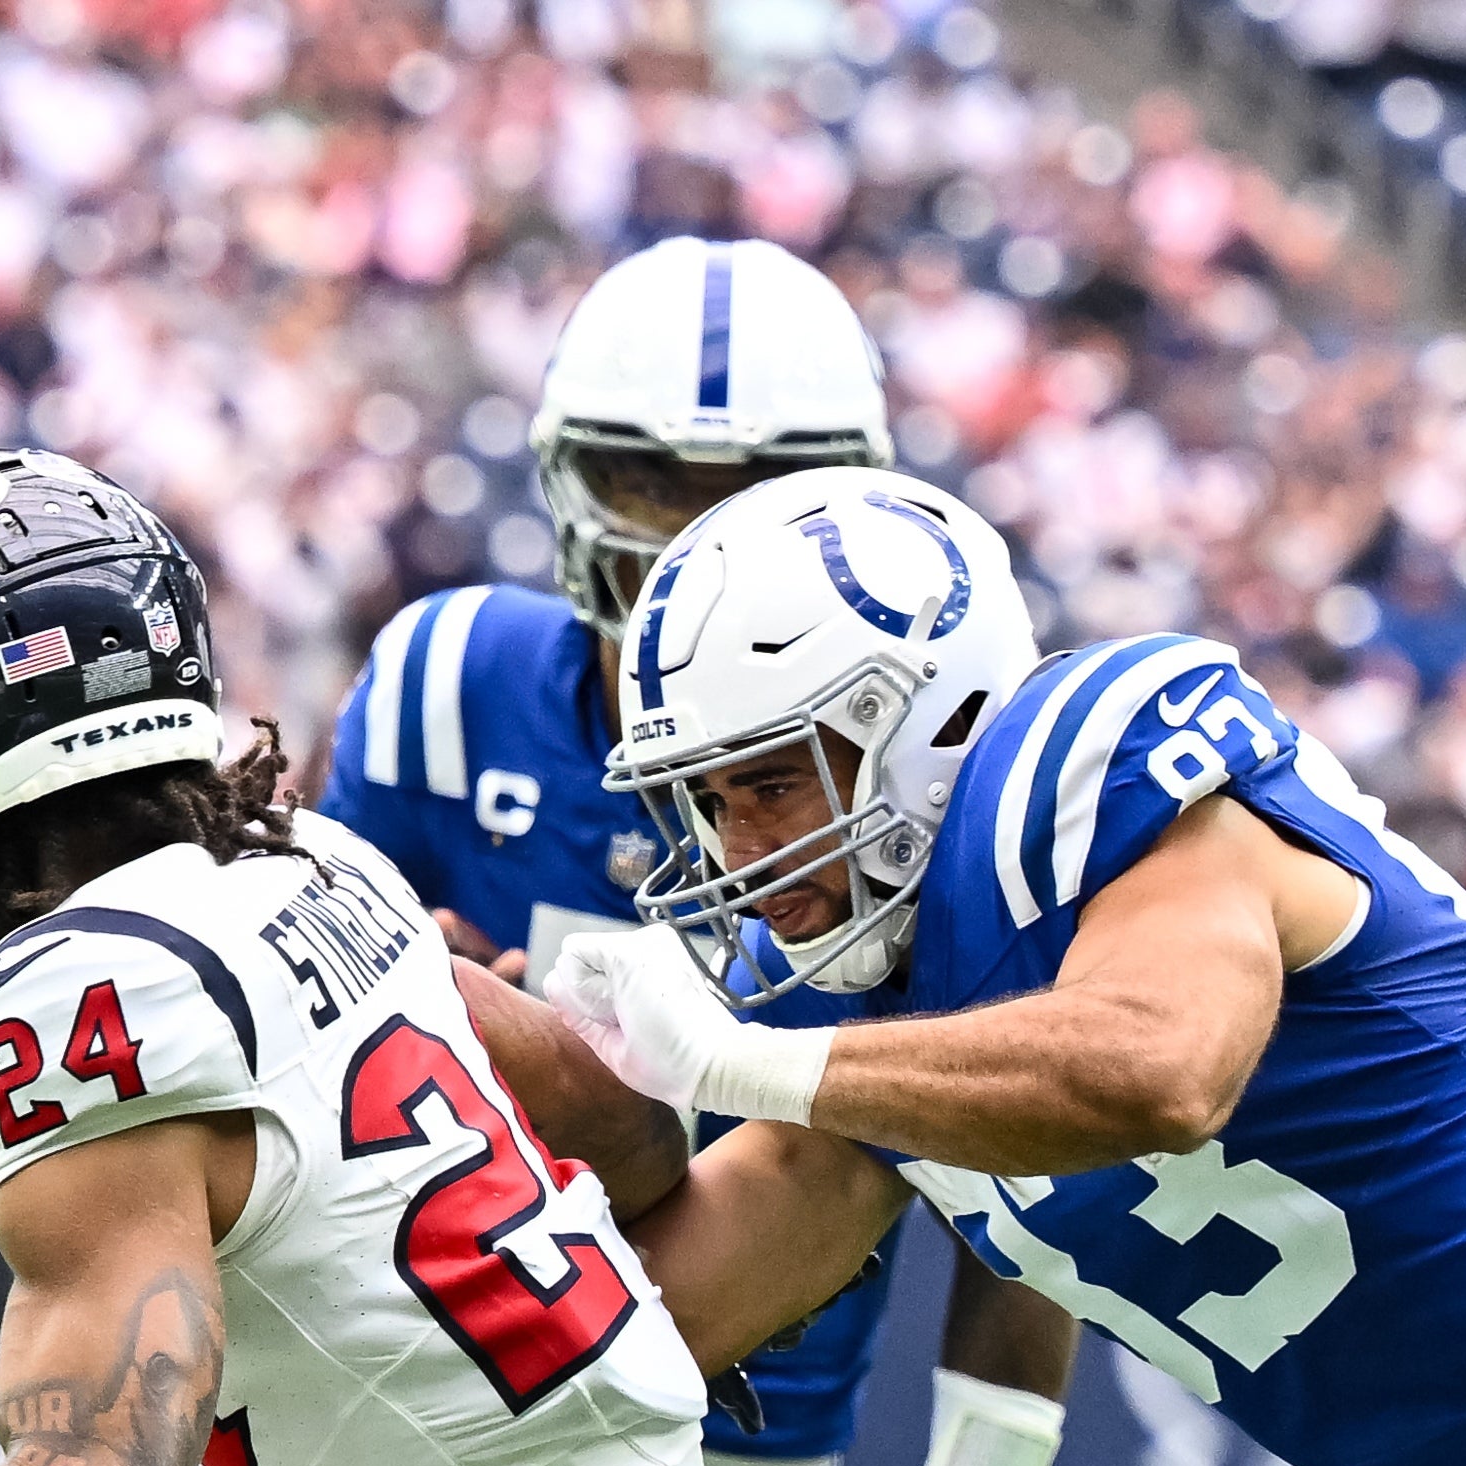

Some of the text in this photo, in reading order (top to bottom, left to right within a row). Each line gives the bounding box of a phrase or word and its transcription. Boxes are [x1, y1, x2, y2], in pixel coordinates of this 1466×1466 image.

[51, 713, 193, 753] TEXANS
[632, 717, 676, 743] COLTS
[475, 768, 541, 837] C
[341, 1012, 639, 1418] 2
